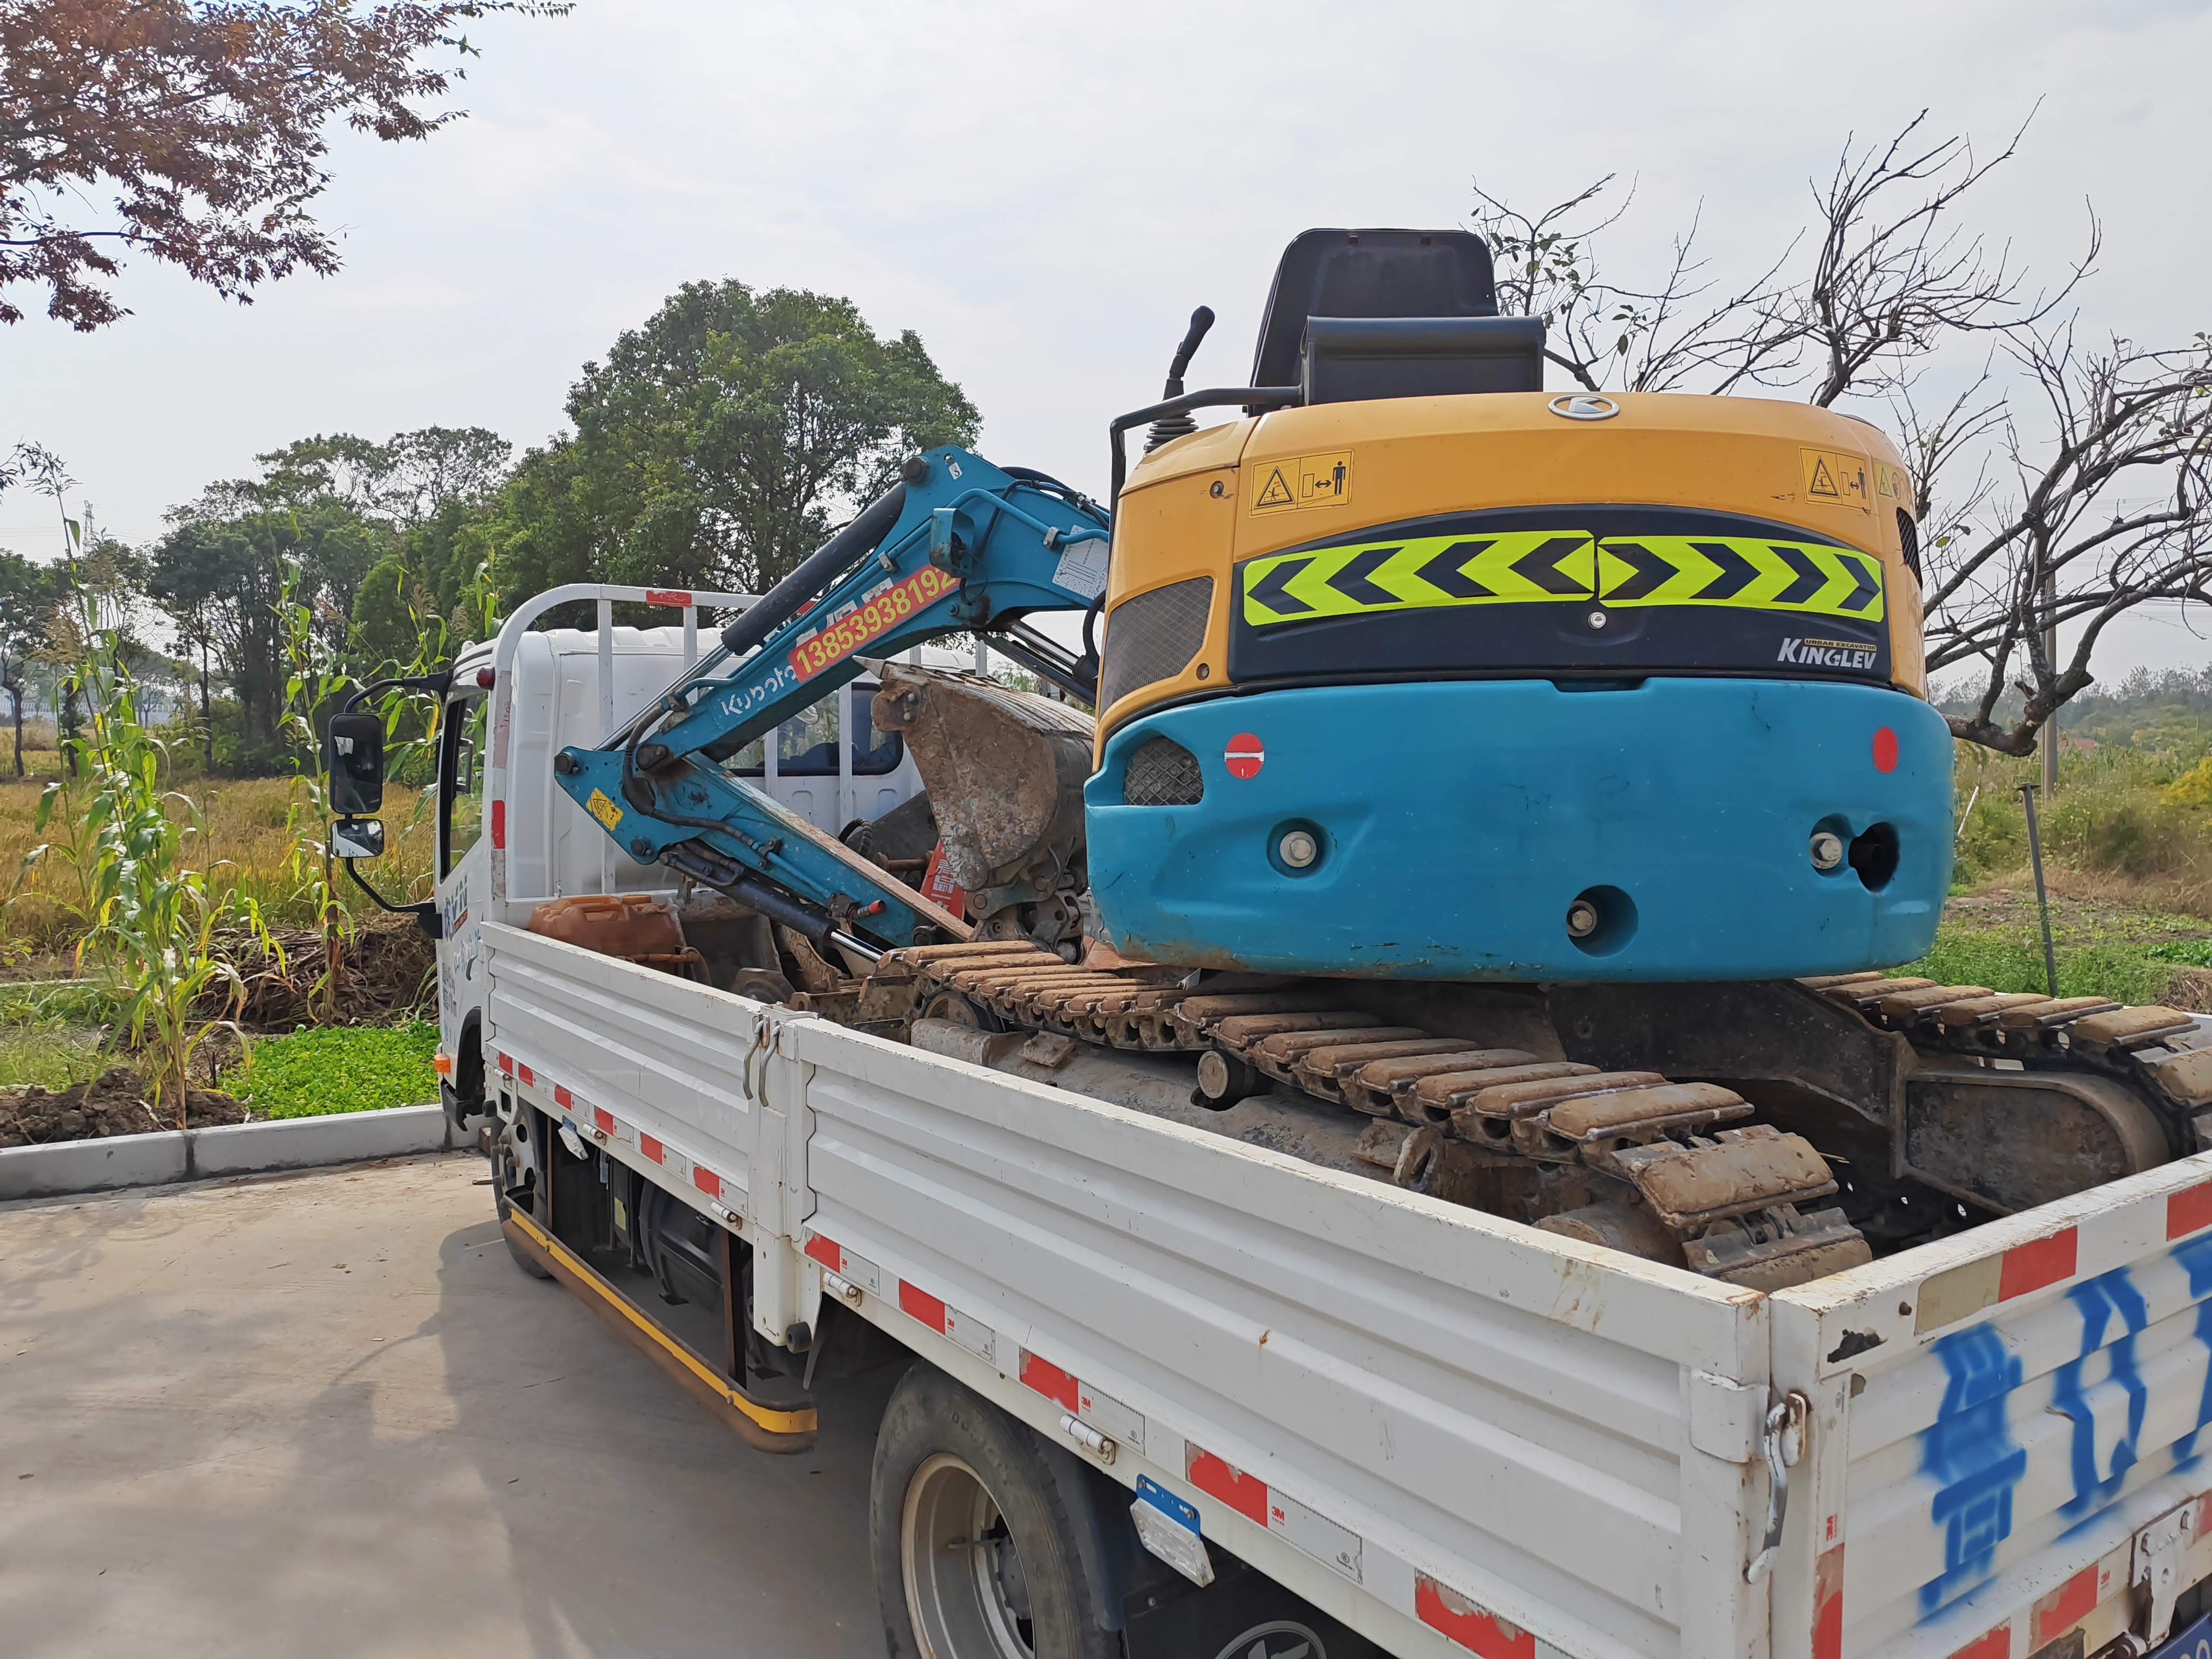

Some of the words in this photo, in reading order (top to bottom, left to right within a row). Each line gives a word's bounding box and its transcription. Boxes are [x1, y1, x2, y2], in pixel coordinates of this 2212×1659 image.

[796, 567, 956, 673] 13853938192
[1837, 642, 1876, 650] EXCAVATOR
[1777, 637, 1877, 670] KINGLEV
[947, 1318, 955, 1328] 3M
[1081, 1396, 1091, 1409] 3M
[1271, 1506, 1285, 1521] 3M
